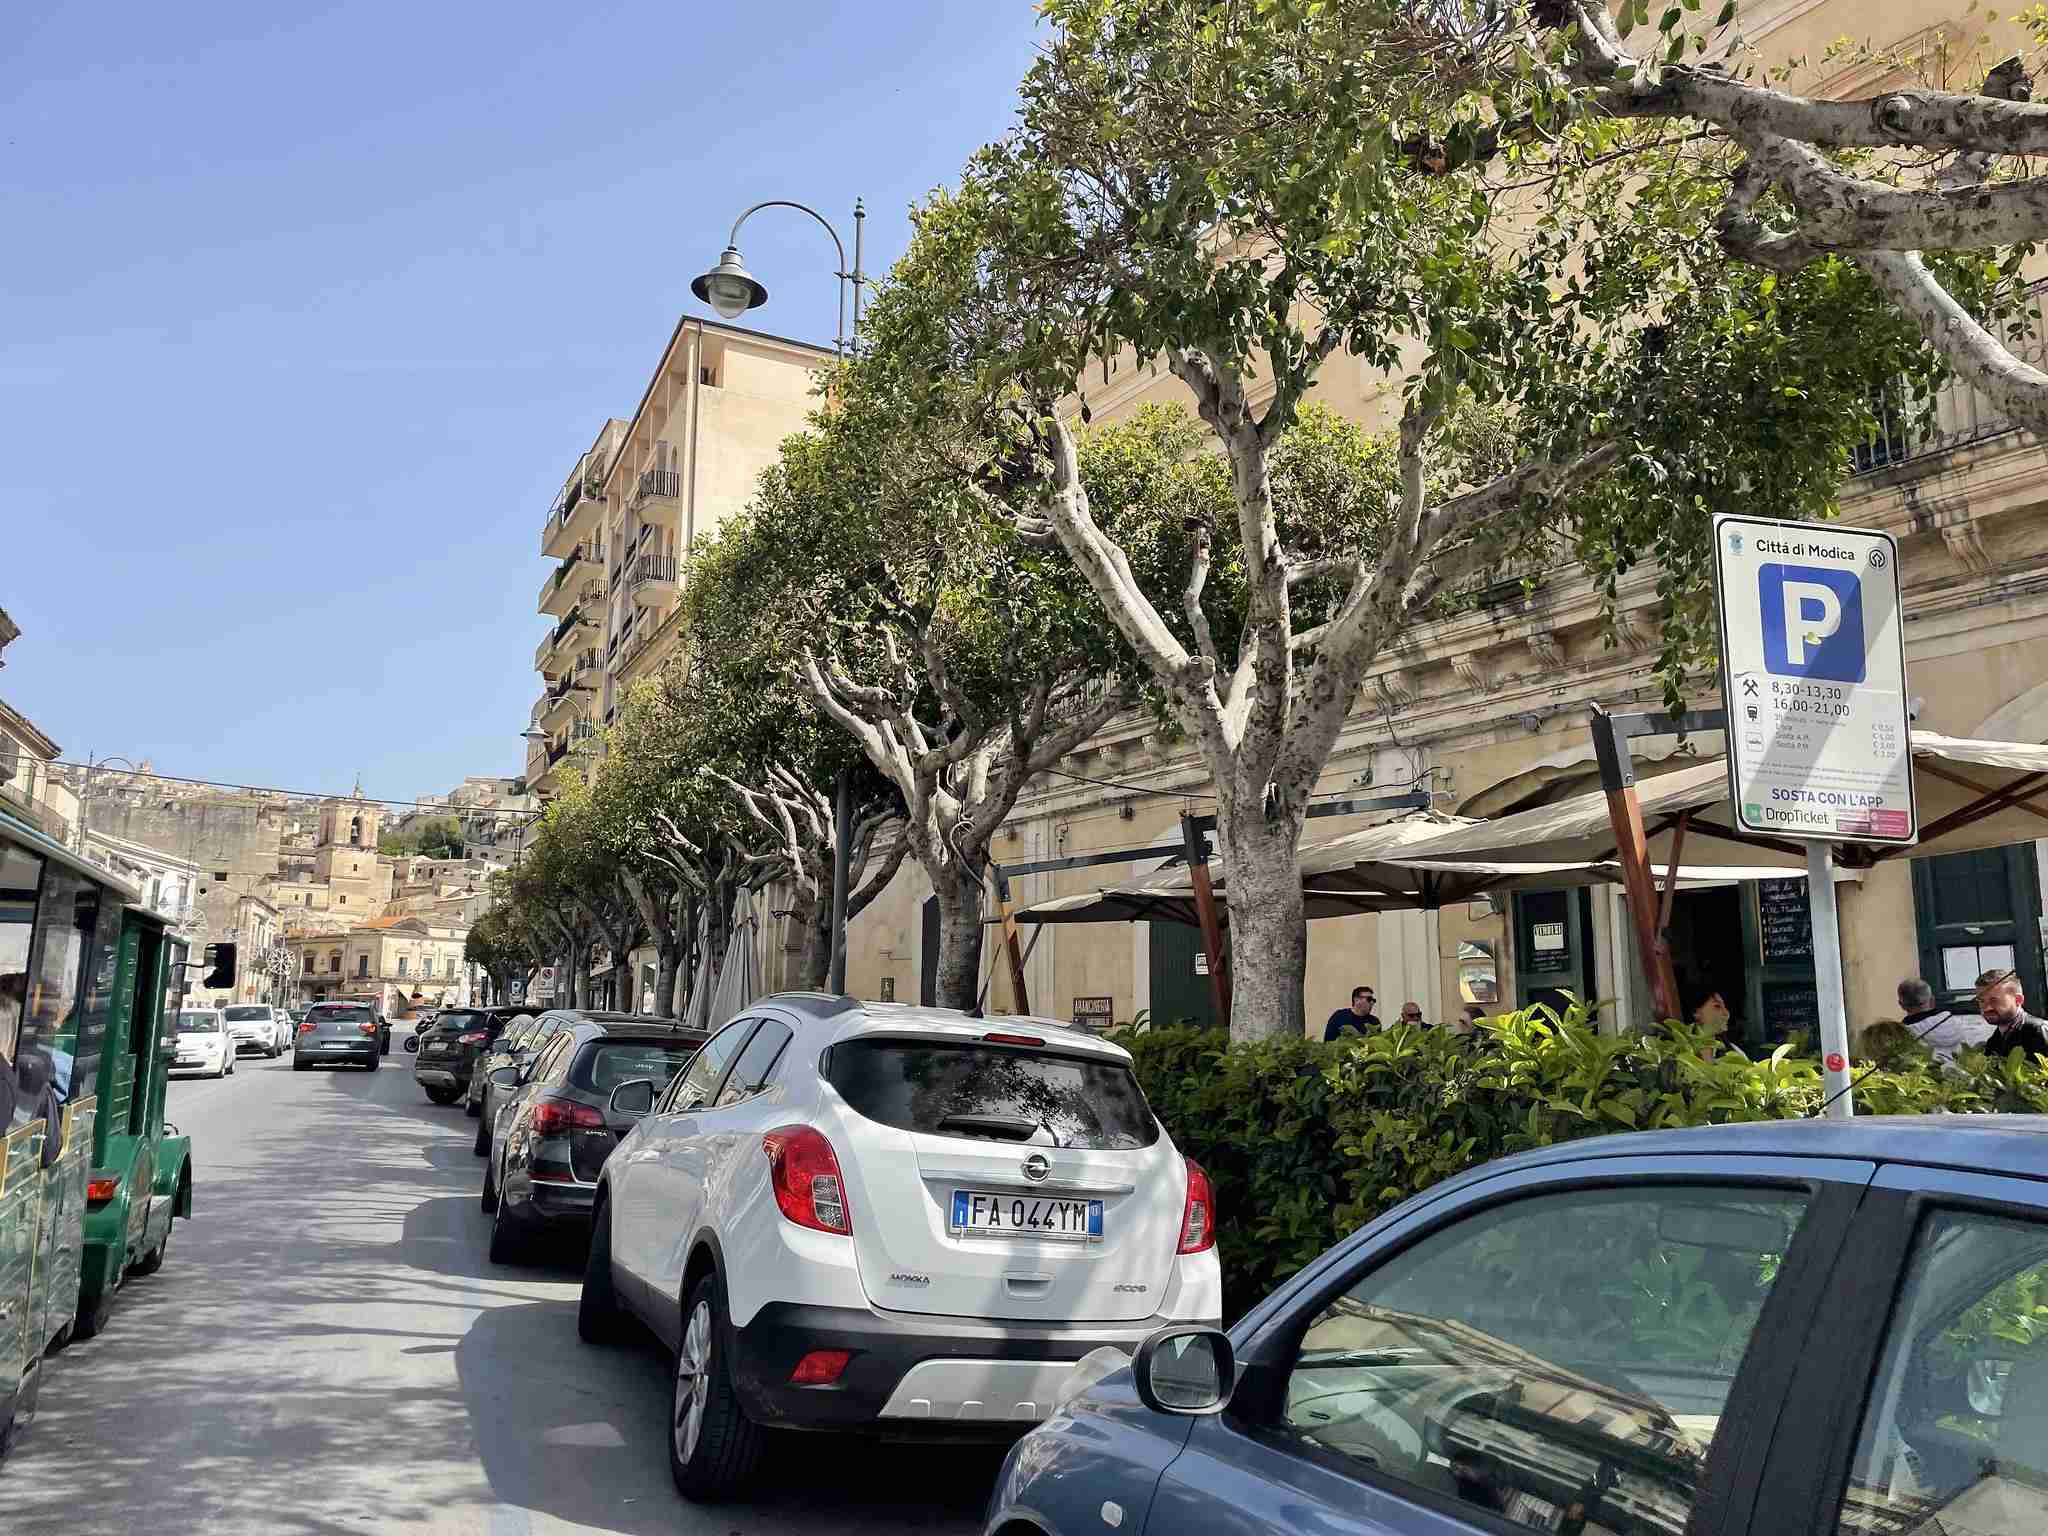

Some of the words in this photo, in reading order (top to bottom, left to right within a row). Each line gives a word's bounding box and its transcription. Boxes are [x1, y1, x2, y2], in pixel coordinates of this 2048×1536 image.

[1792, 544, 1804, 556] di
[1809, 545, 1855, 560] Modica
[1783, 581, 1841, 664] P
[1771, 681, 1841, 700] 8,30-13,30
[1773, 698, 1850, 716] 16,00-21,00
[1772, 788, 1815, 802] SOSTA
[1816, 792, 1846, 806] CON
[1849, 795, 1884, 808] L'APP
[1766, 807, 1829, 824] DropTicket
[972, 1196, 1001, 1226] FA
[1011, 1199, 1086, 1231] 044YM
